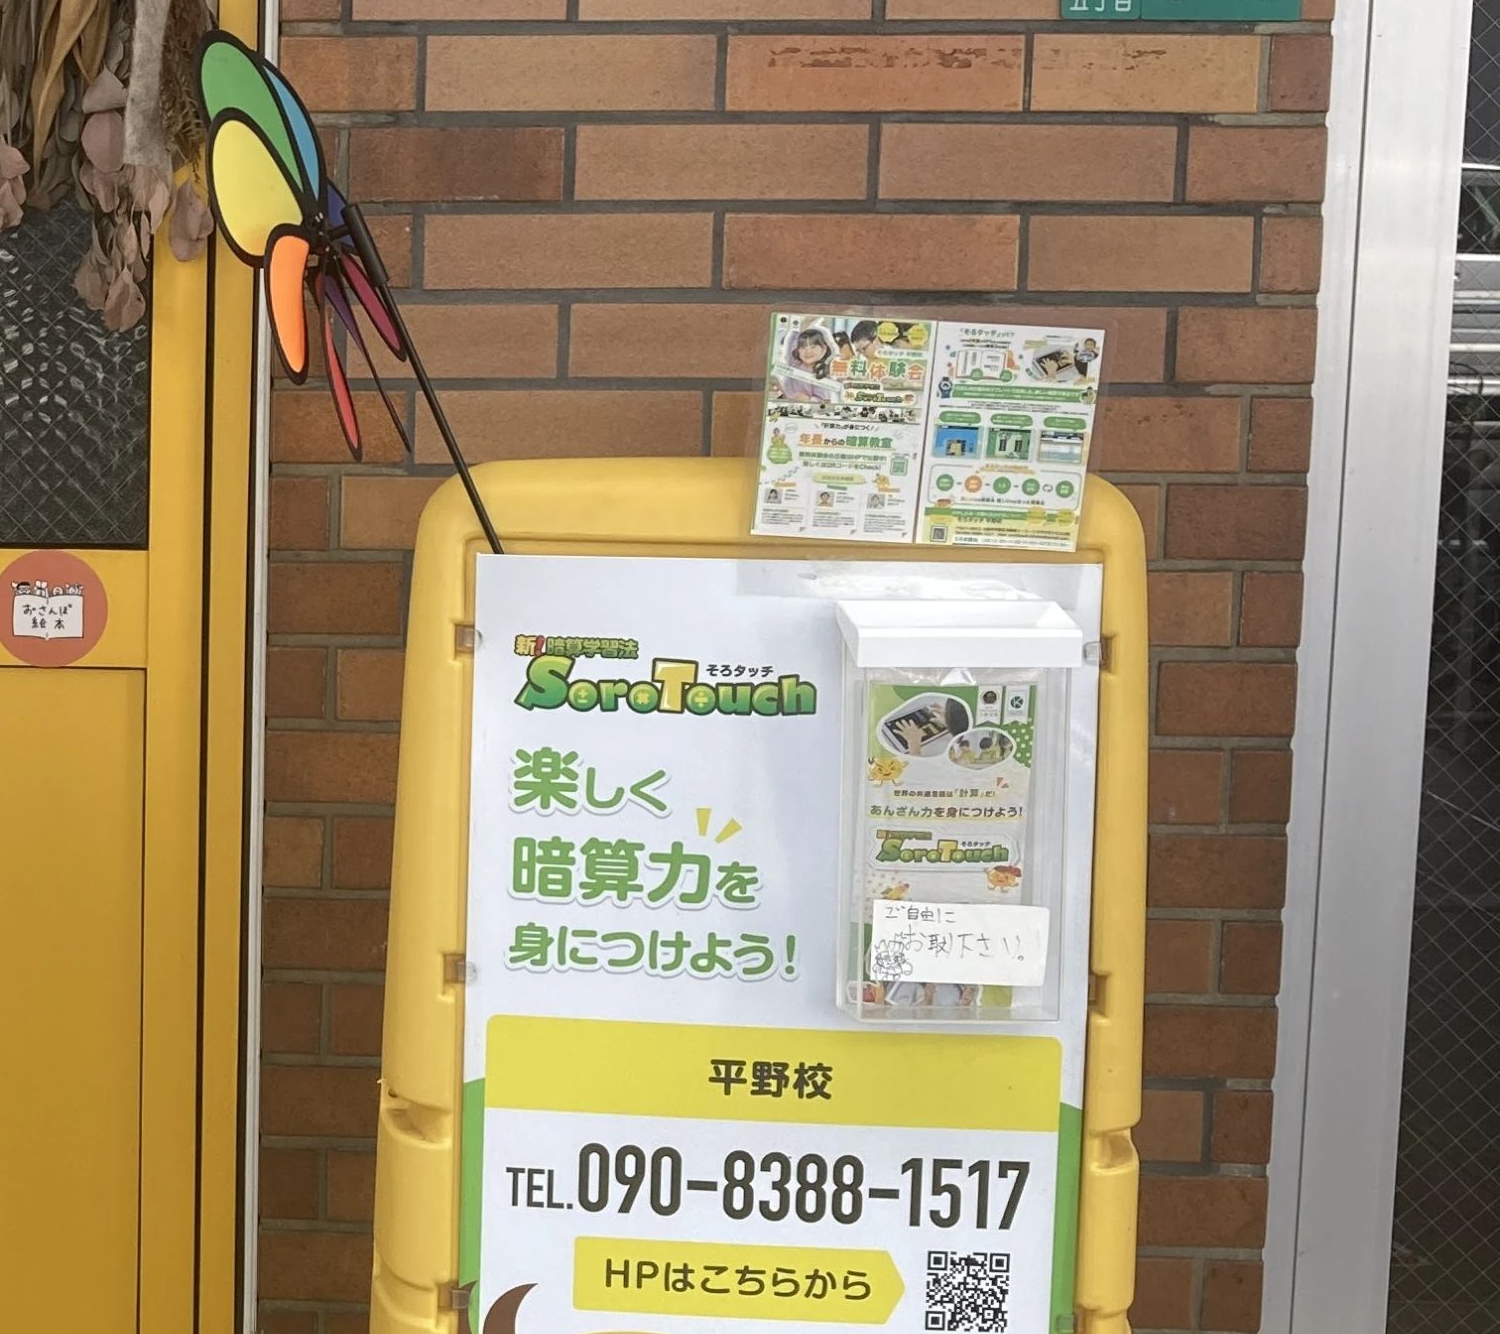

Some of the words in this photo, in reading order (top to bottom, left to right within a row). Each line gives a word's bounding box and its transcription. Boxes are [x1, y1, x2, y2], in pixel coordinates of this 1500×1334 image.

[830, 359, 925, 382] 無料体験会
[22, 603, 73, 617] おさんぽ
[31, 617, 65, 630] 絵本
[706, 664, 774, 678] そろタッチ
[514, 655, 817, 716] SoroTouch
[514, 747, 667, 812] 楽しく
[869, 804, 1024, 819] あんざん力を身につけよう!
[876, 839, 1009, 862] SoroTouch
[513, 836, 758, 903] 暗算力を
[885, 905, 957, 923] ご自由に
[510, 923, 796, 975] 身につけよう!
[708, 1058, 833, 1100] 平野校
[605, 1258, 871, 1301] HPはこちらから
